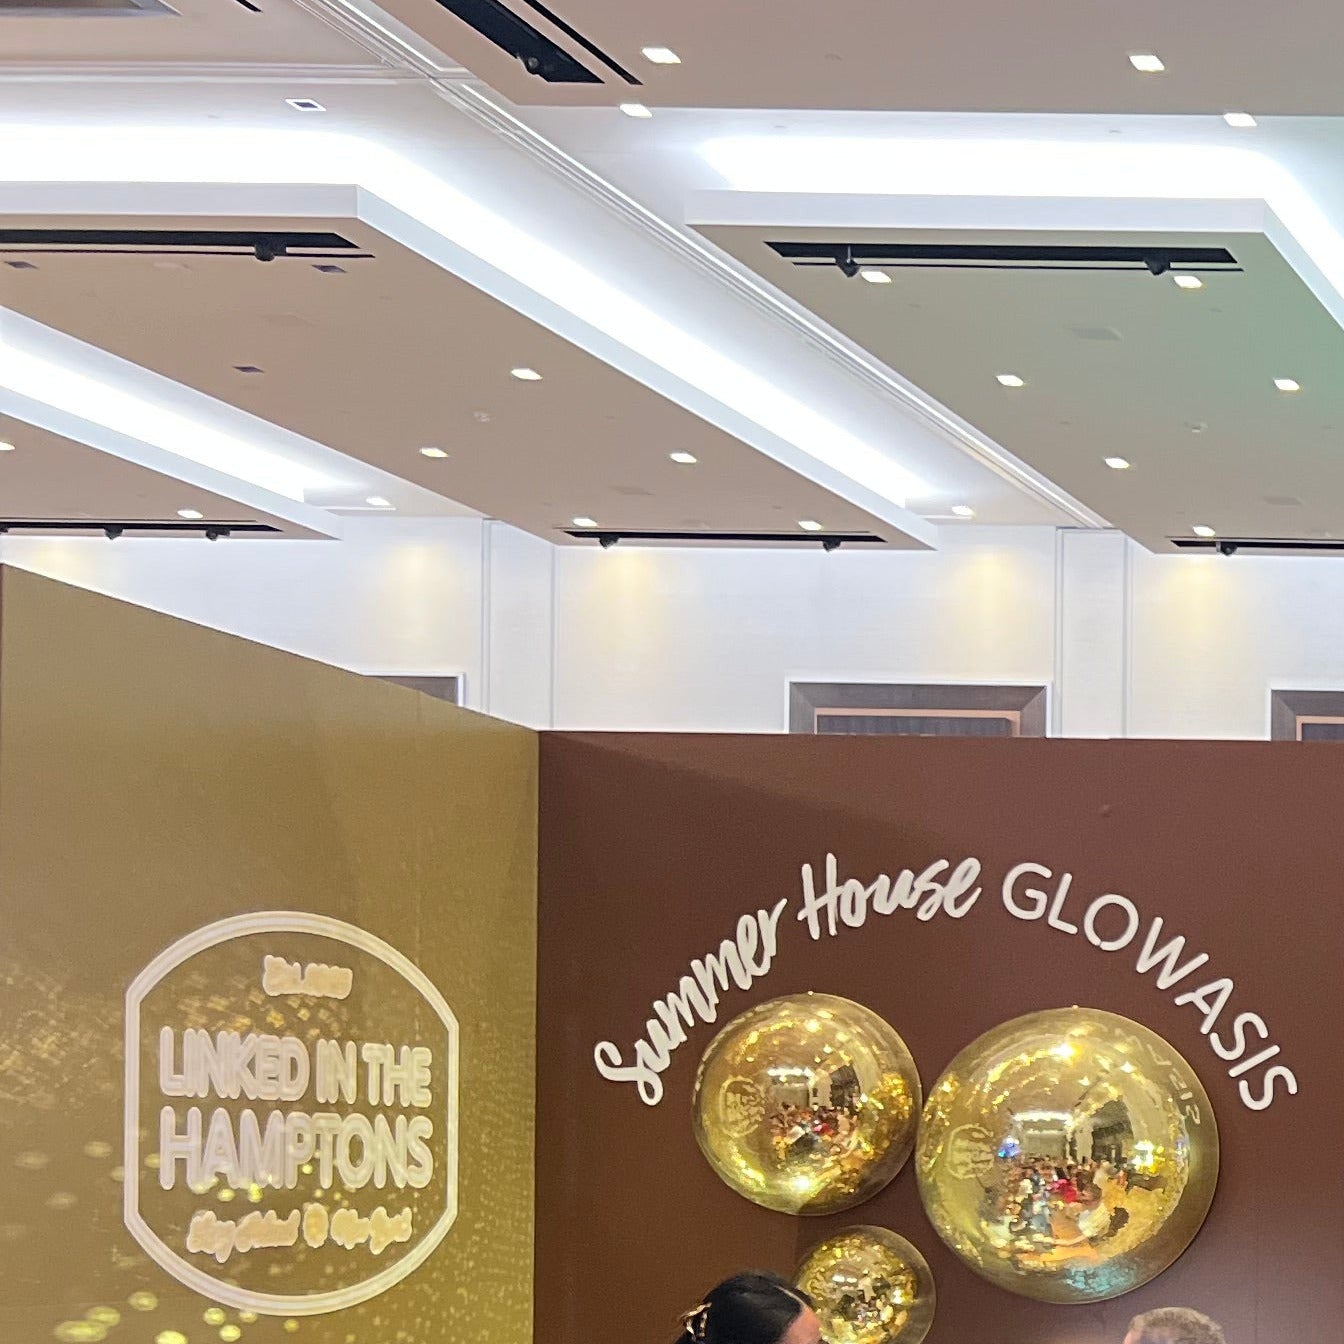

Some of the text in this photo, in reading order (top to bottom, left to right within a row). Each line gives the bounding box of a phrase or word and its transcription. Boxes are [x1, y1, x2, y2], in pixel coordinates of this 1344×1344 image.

[594, 898, 788, 1106] Summer
[797, 852, 983, 940] House
[1001, 862, 1298, 1111] GLOWASIS
[159, 1025, 433, 1108] LINKED IN THE
[159, 1105, 434, 1191] HAMPTONS
